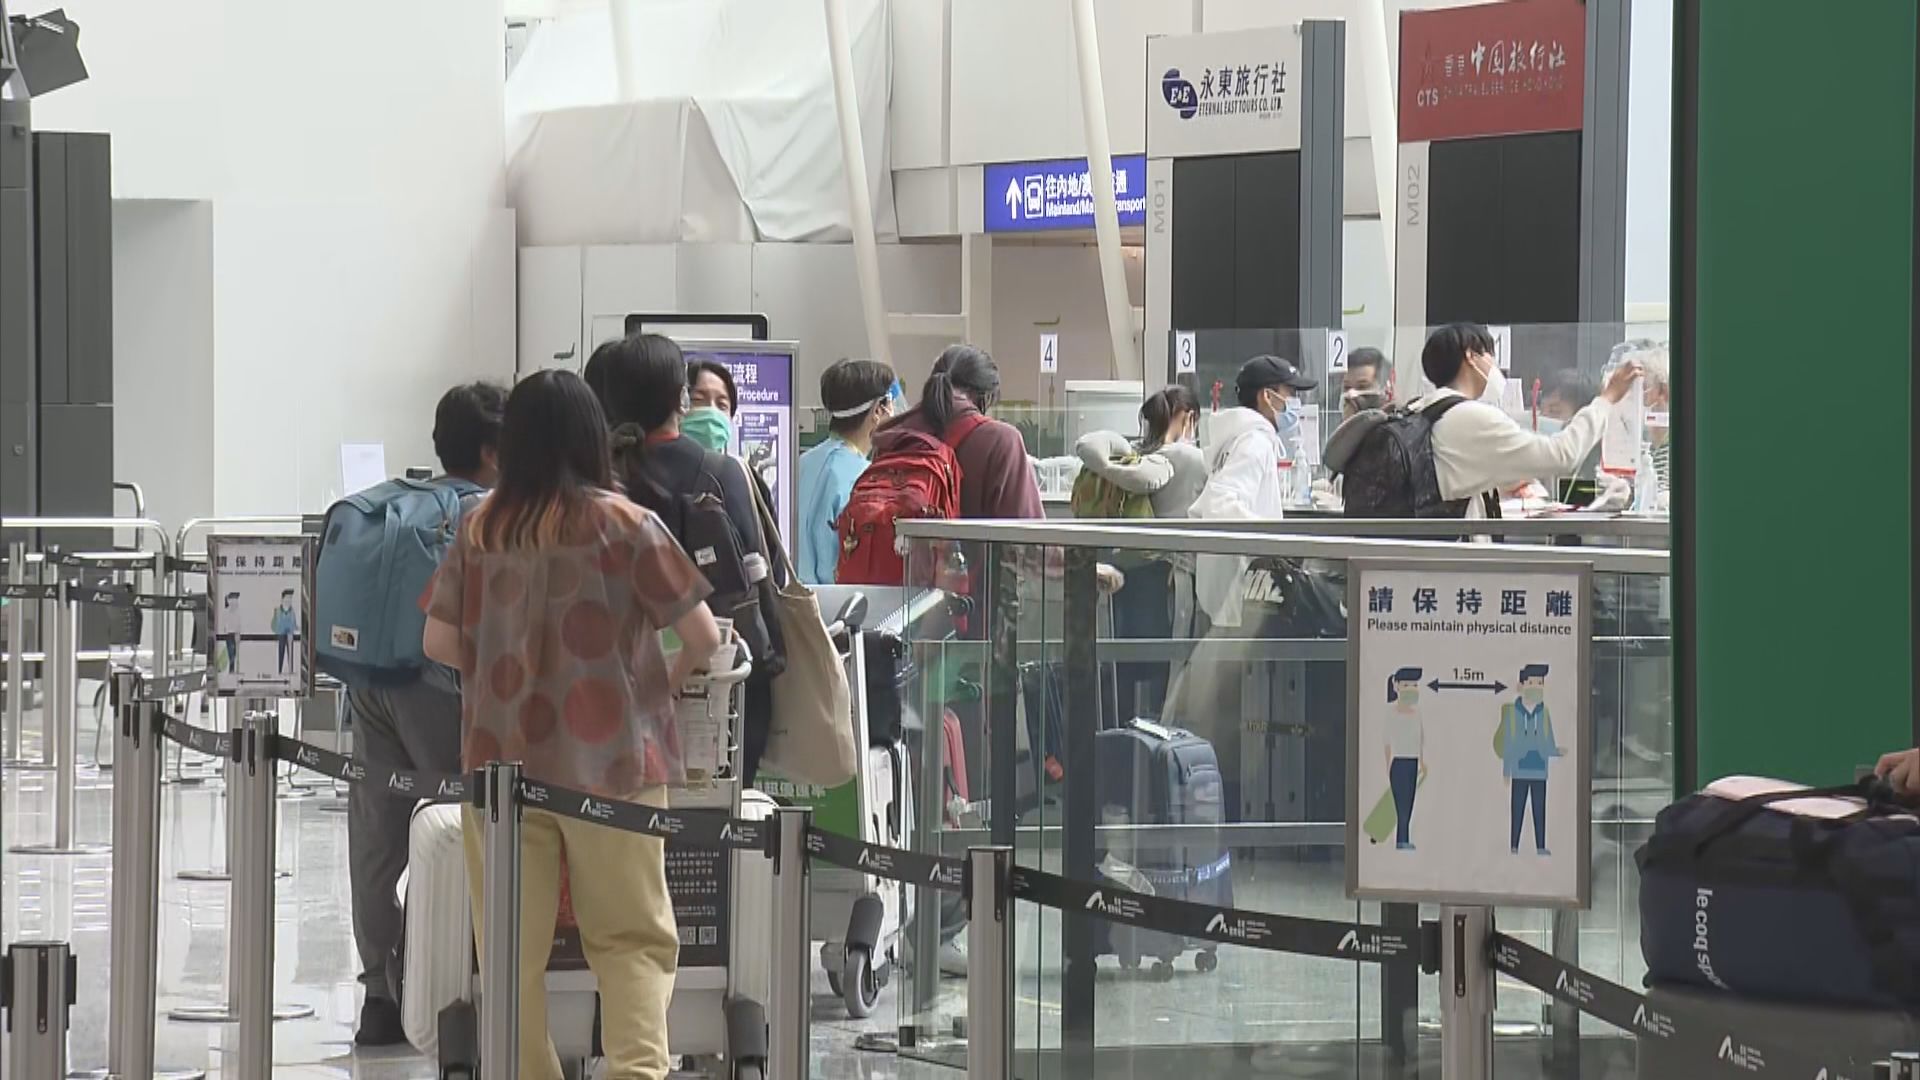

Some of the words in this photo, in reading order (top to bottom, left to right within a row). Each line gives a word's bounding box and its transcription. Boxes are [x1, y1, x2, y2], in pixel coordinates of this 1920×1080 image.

[1199, 61, 1287, 99] 永東旅行社
[1199, 101, 1223, 117] ETERNAL
[1224, 100, 1238, 115] EAST
[1239, 98, 1258, 114] TOURS
[1259, 97, 1269, 112] CO.
[1417, 88, 1439, 106] CTS
[1114, 196, 1146, 215] ransport
[1154, 179, 1166, 233] M01
[1407, 164, 1420, 226] M02
[1044, 340, 1053, 367] 4
[1182, 338, 1192, 367] 3
[1333, 336, 1344, 367] 2
[737, 386, 779, 401] Procedure
[1368, 586, 1573, 617] 請保持距離
[1367, 618, 1408, 632] Please
[1410, 619, 1464, 633] maintain
[1466, 620, 1517, 636] physical
[1520, 621, 1572, 635] distance
[1453, 668, 1485, 681] 1.5m
[1696, 888, 1713, 908] le
[1693, 910, 1708, 951] coq
